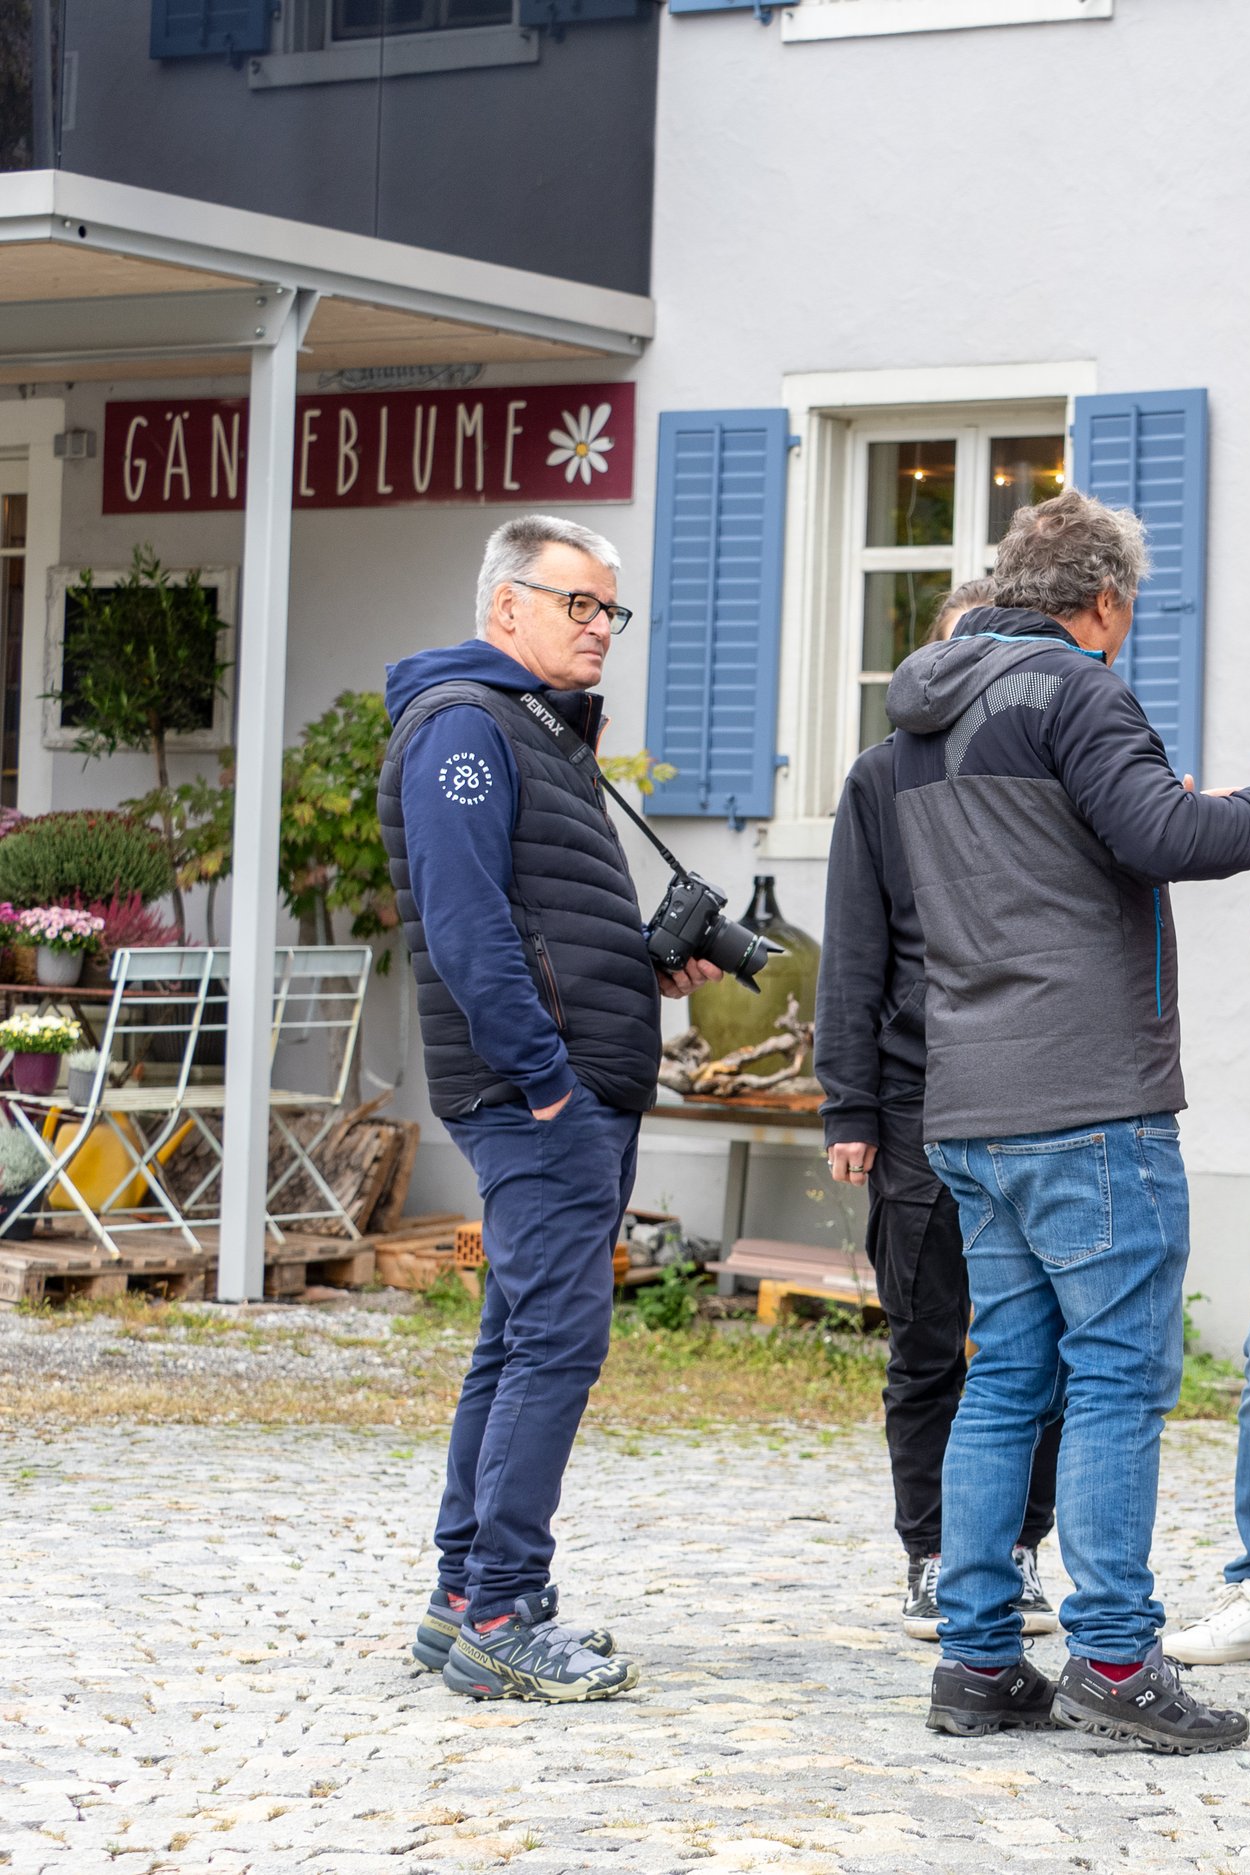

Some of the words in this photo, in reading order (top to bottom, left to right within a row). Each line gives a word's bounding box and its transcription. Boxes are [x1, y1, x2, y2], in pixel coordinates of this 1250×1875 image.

[123, 400, 527, 502] GÄNEBLUME
[520, 693, 564, 736] PENTAX
[438, 768, 448, 782] BE
[445, 752, 475, 765] YOUR
[478, 759, 493, 787] BEST
[446, 791, 485, 806] SPORTS
